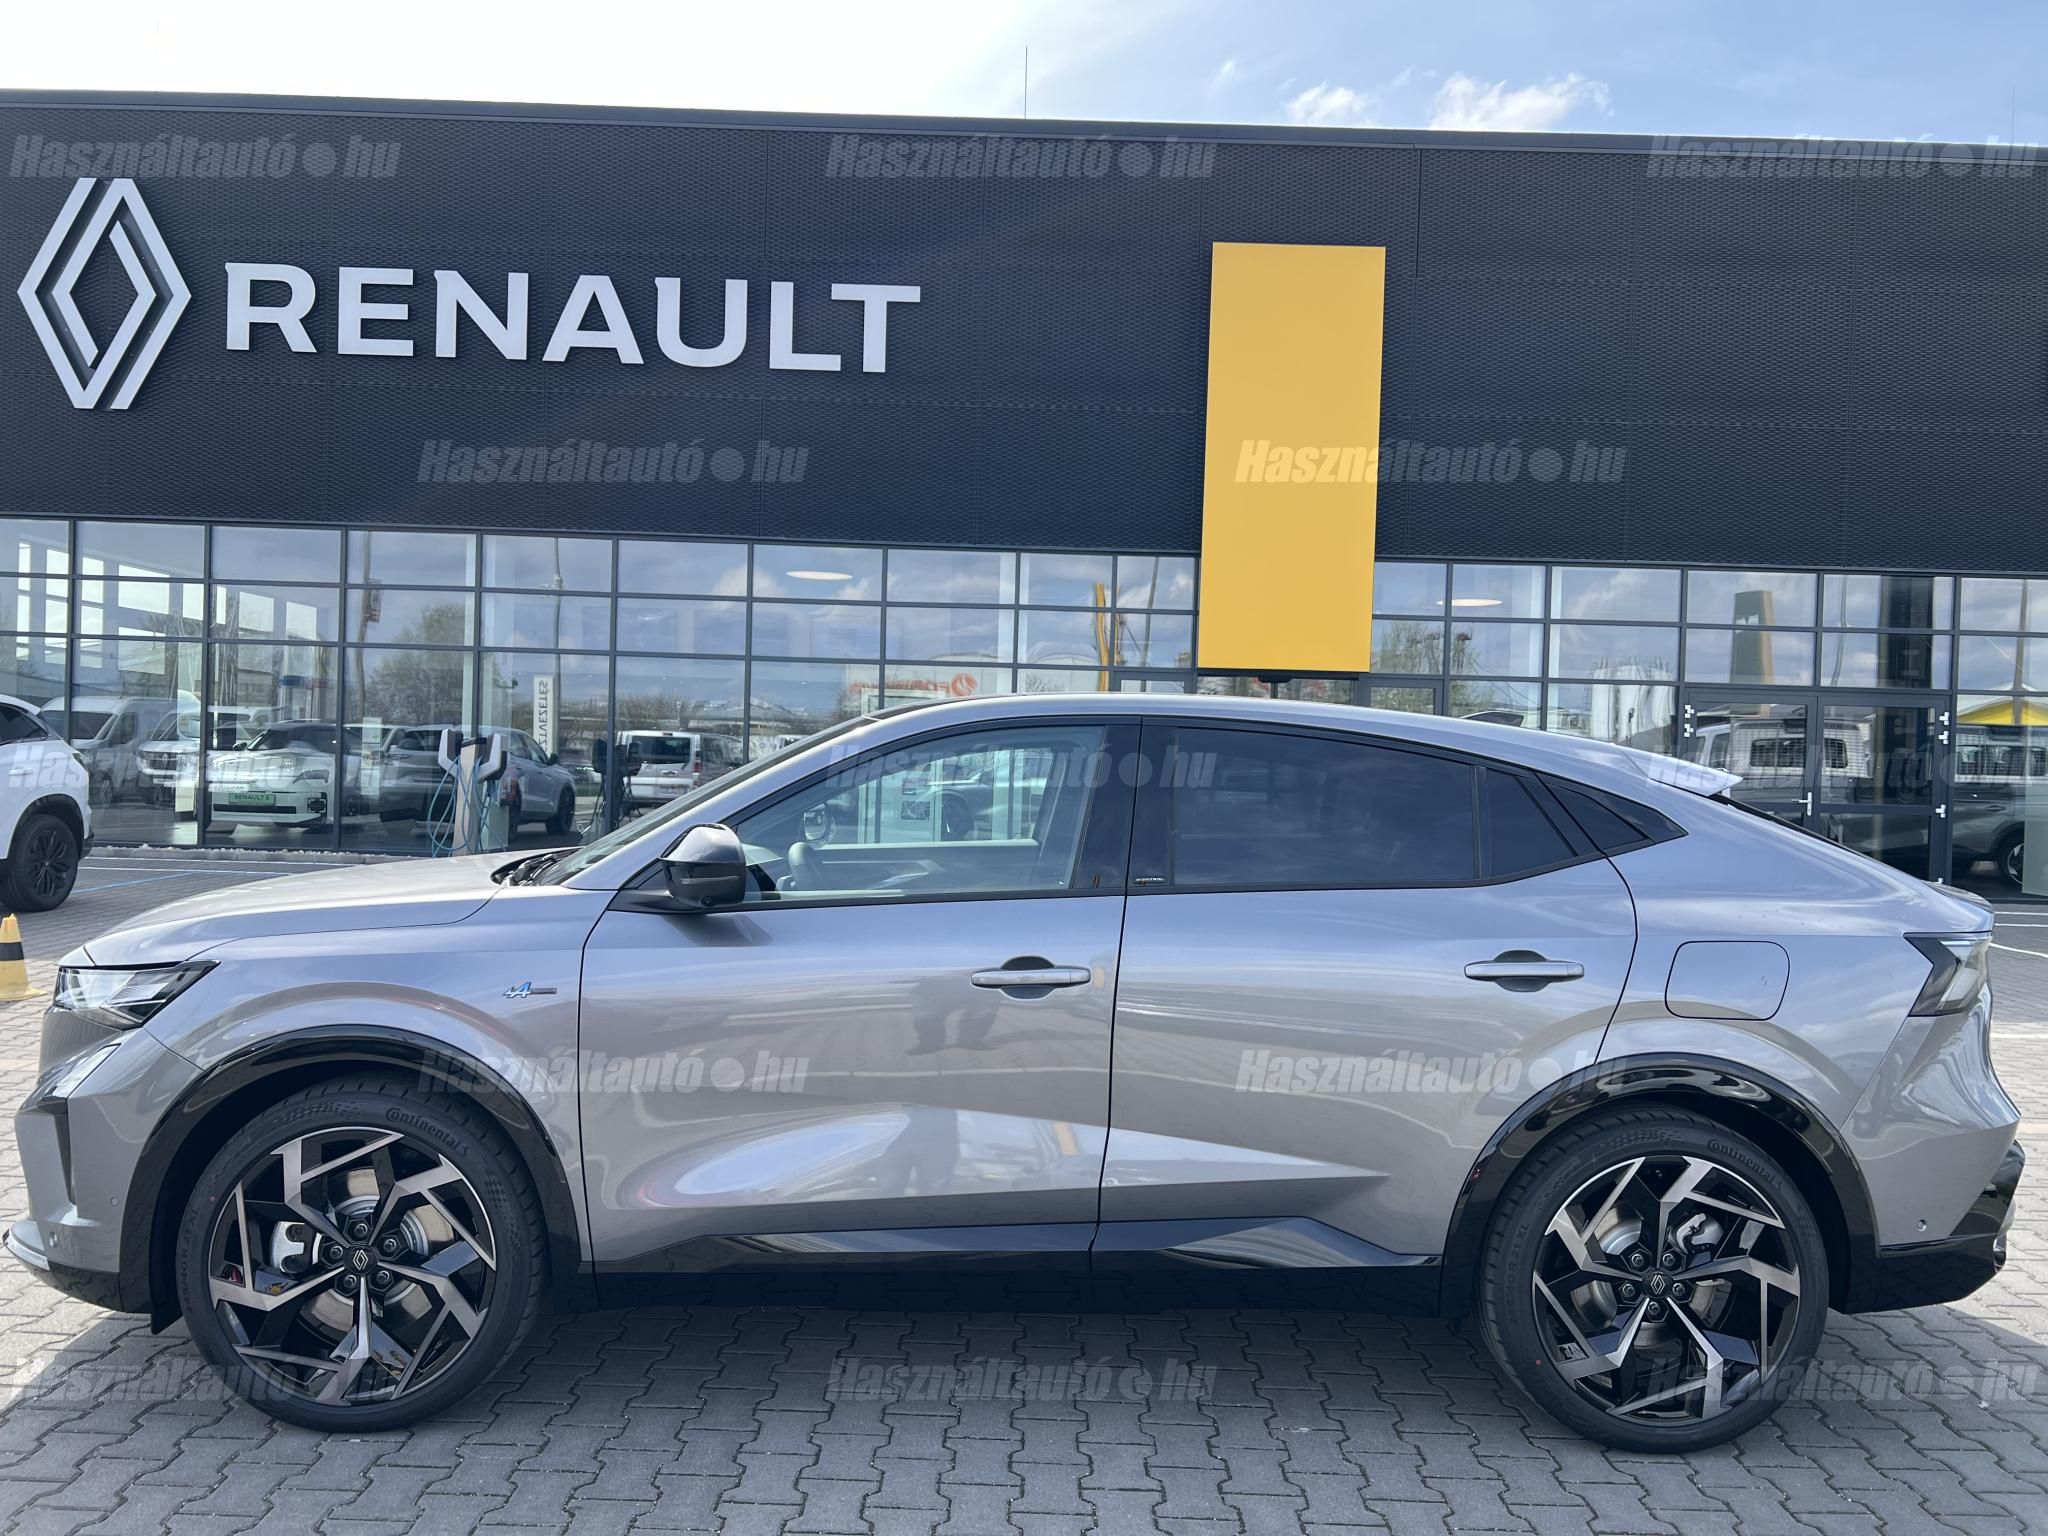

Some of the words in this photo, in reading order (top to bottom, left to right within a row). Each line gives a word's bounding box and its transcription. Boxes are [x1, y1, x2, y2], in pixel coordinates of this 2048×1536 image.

[226, 262, 921, 374] RENAULT
[384, 1107, 462, 1151] Continental
[1707, 1139, 1776, 1184] Continental
